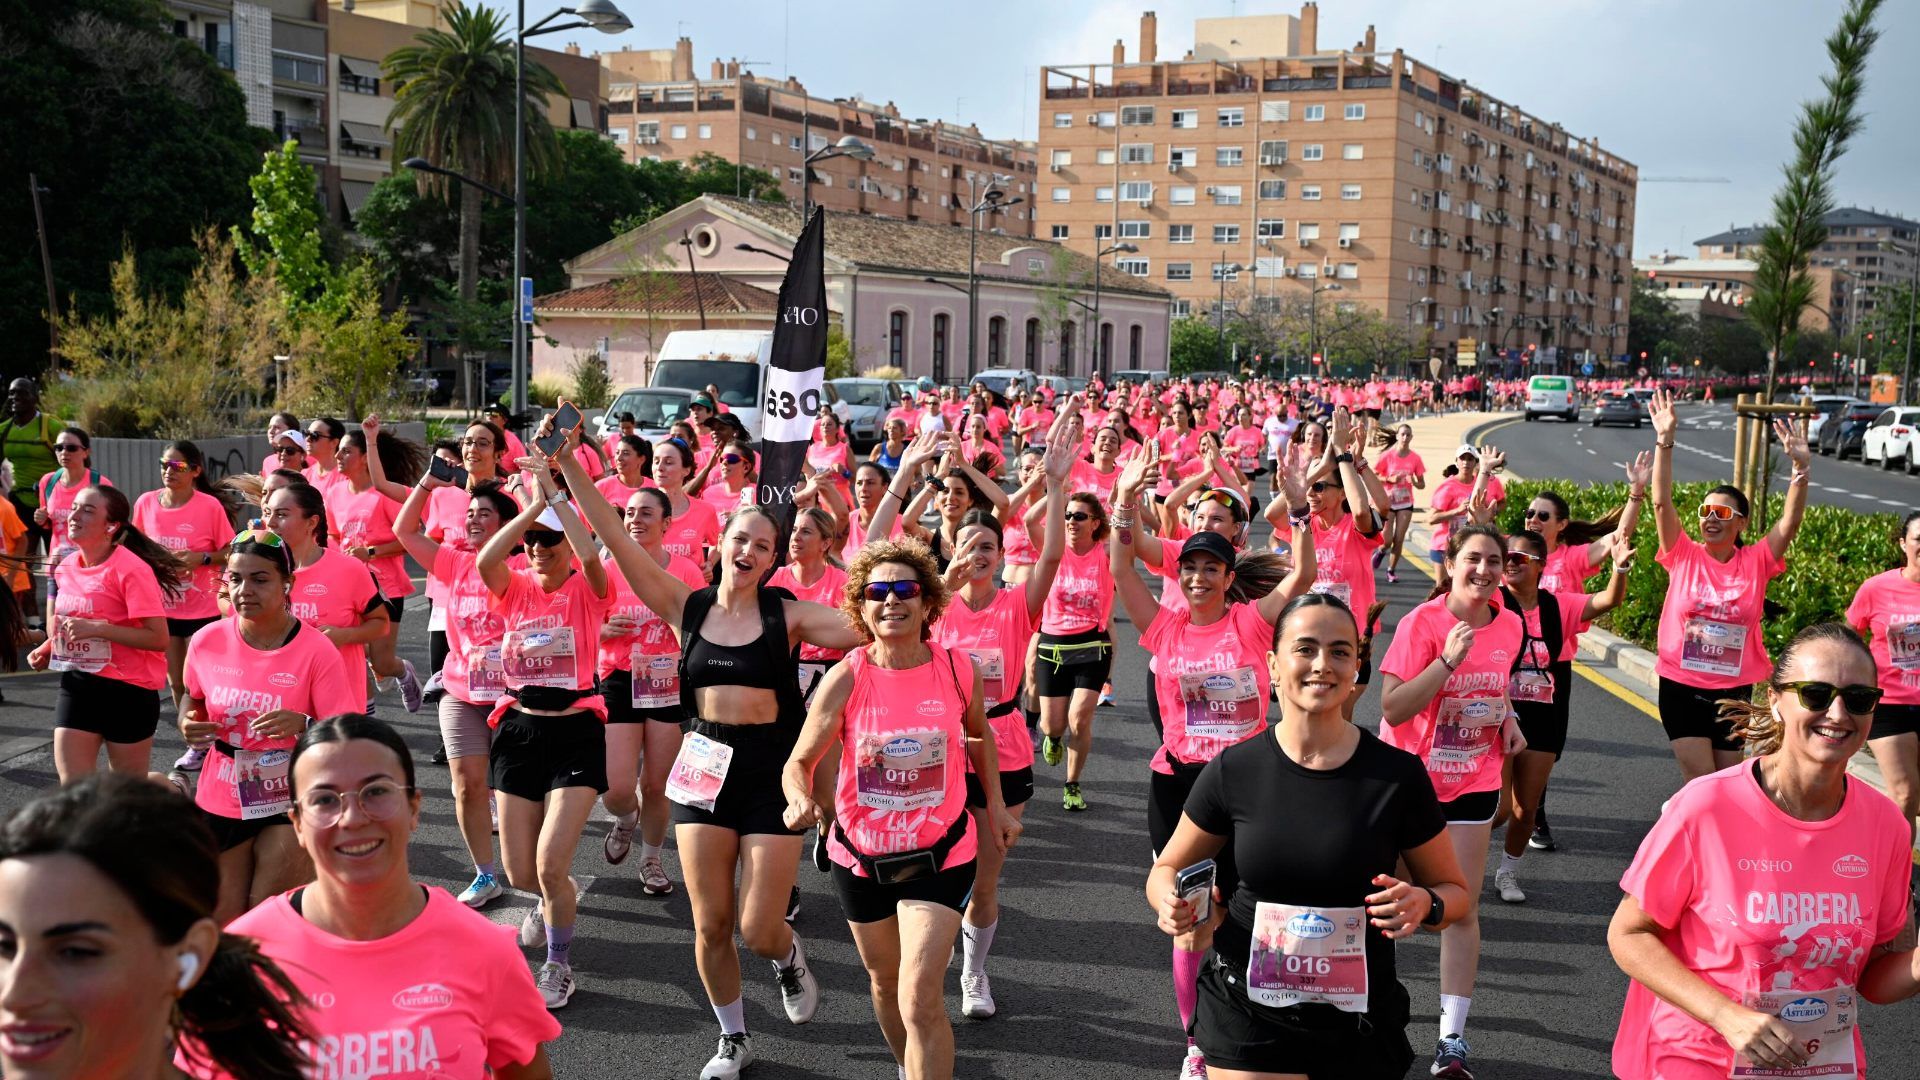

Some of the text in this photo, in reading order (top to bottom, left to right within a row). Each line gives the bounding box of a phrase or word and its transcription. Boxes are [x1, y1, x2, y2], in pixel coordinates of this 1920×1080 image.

[66, 642, 90, 652] 016
[1701, 644, 1725, 655] 016
[525, 656, 553, 668] 016
[708, 659, 733, 667] OYSHO
[652, 678, 673, 688] 016
[1443, 671, 1505, 692] CARRERA
[1519, 684, 1540, 694] 016
[211, 686, 282, 713] CARRERA
[1209, 701, 1237, 712] 016
[1459, 727, 1482, 738] 016
[885, 746, 919, 754] ASTURIANA
[679, 763, 702, 782] 016
[886, 769, 919, 783] 016
[867, 796, 894, 806] OYSHO
[251, 806, 277, 815] OYSHO
[888, 811, 907, 831] LA
[1738, 858, 1793, 872] OYSHO
[1835, 864, 1868, 874] ASTURIANA
[1746, 890, 1863, 925] CARRERA
[1290, 921, 1332, 933] ASTURIANA
[1286, 956, 1331, 975] 016
[1300, 976, 1316, 985] 337
[1303, 985, 1324, 993] MUJER
[399, 992, 449, 1007] ASTURIANA
[1261, 992, 1297, 1001] OYSHO
[1755, 1001, 1779, 1009] SUMA
[1784, 1006, 1826, 1018] ASTURIANA
[1815, 1066, 1842, 1074] VALENCIA
